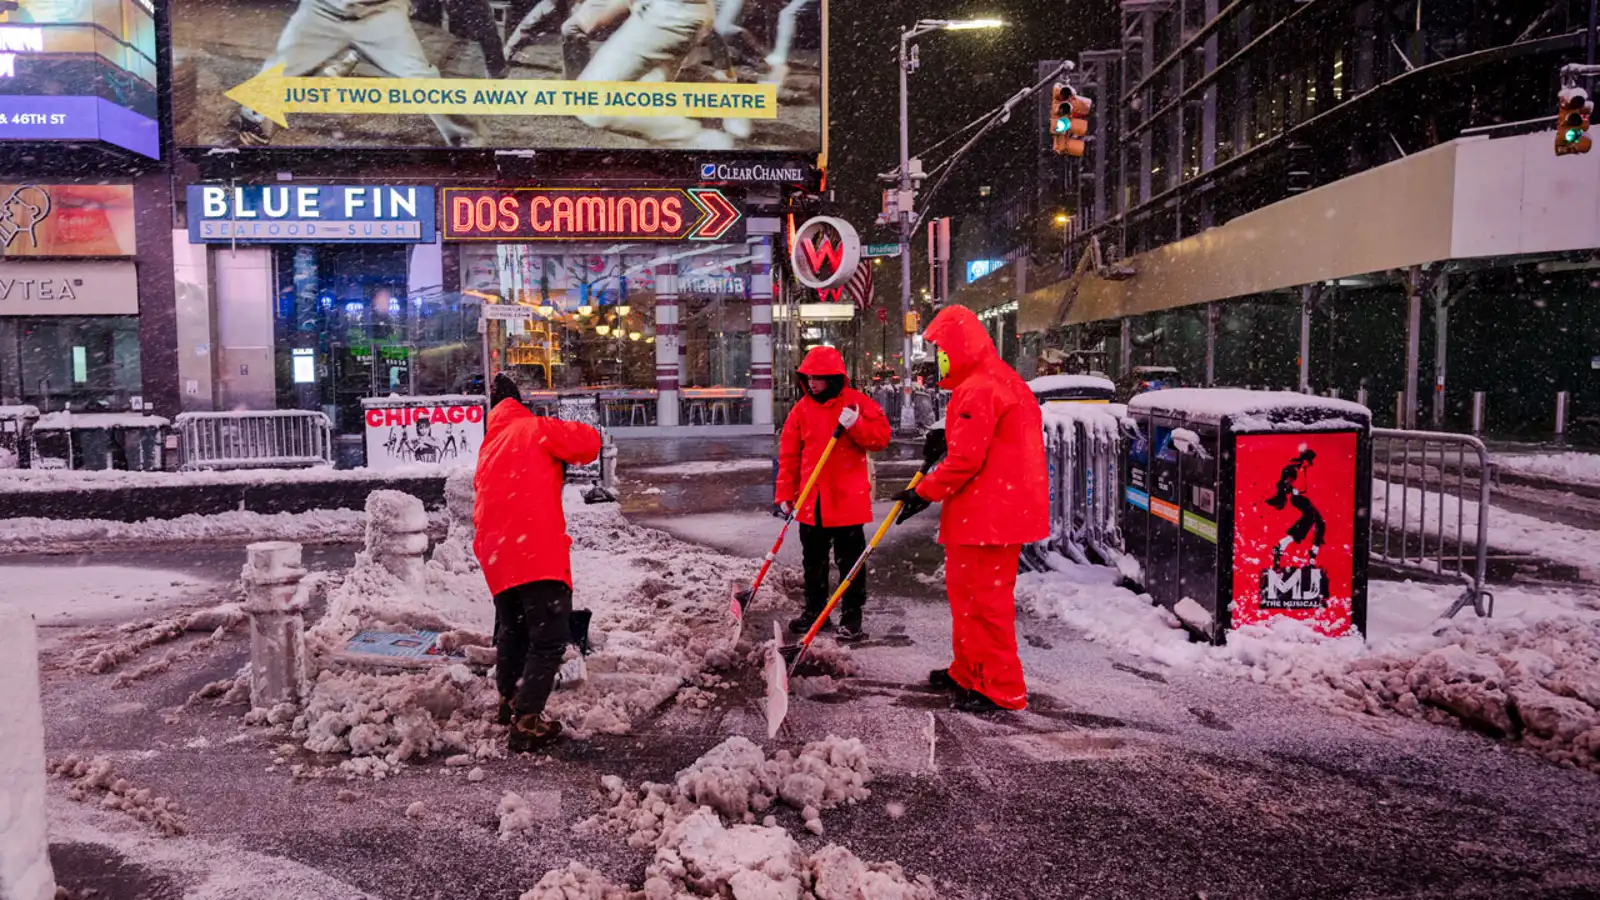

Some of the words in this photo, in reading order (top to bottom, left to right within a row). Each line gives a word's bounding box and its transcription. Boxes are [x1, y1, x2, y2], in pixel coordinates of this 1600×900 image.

[284, 88, 331, 103] JUST
[336, 88, 382, 103] TWO
[388, 89, 467, 104] BLOCKS
[473, 90, 528, 104] AWAY
[534, 91, 557, 106] AT
[562, 91, 599, 106] THE
[604, 92, 677, 107] JACOBS
[683, 93, 766, 109] THEATRE
[11, 114, 47, 124] 46TH
[50, 114, 67, 124] ST
[203, 187, 320, 217] BLUE
[344, 187, 416, 218] FIN
[453, 196, 520, 232] DOS
[530, 196, 683, 233] CAMINOS
[204, 223, 316, 236] SEAFOOD
[349, 223, 417, 236] SUSHI
[802, 237, 844, 274] W
[365, 405, 484, 427] CHICAGO
[1267, 568, 1321, 600] MJ
[1283, 600, 1320, 608] MUSICAL
